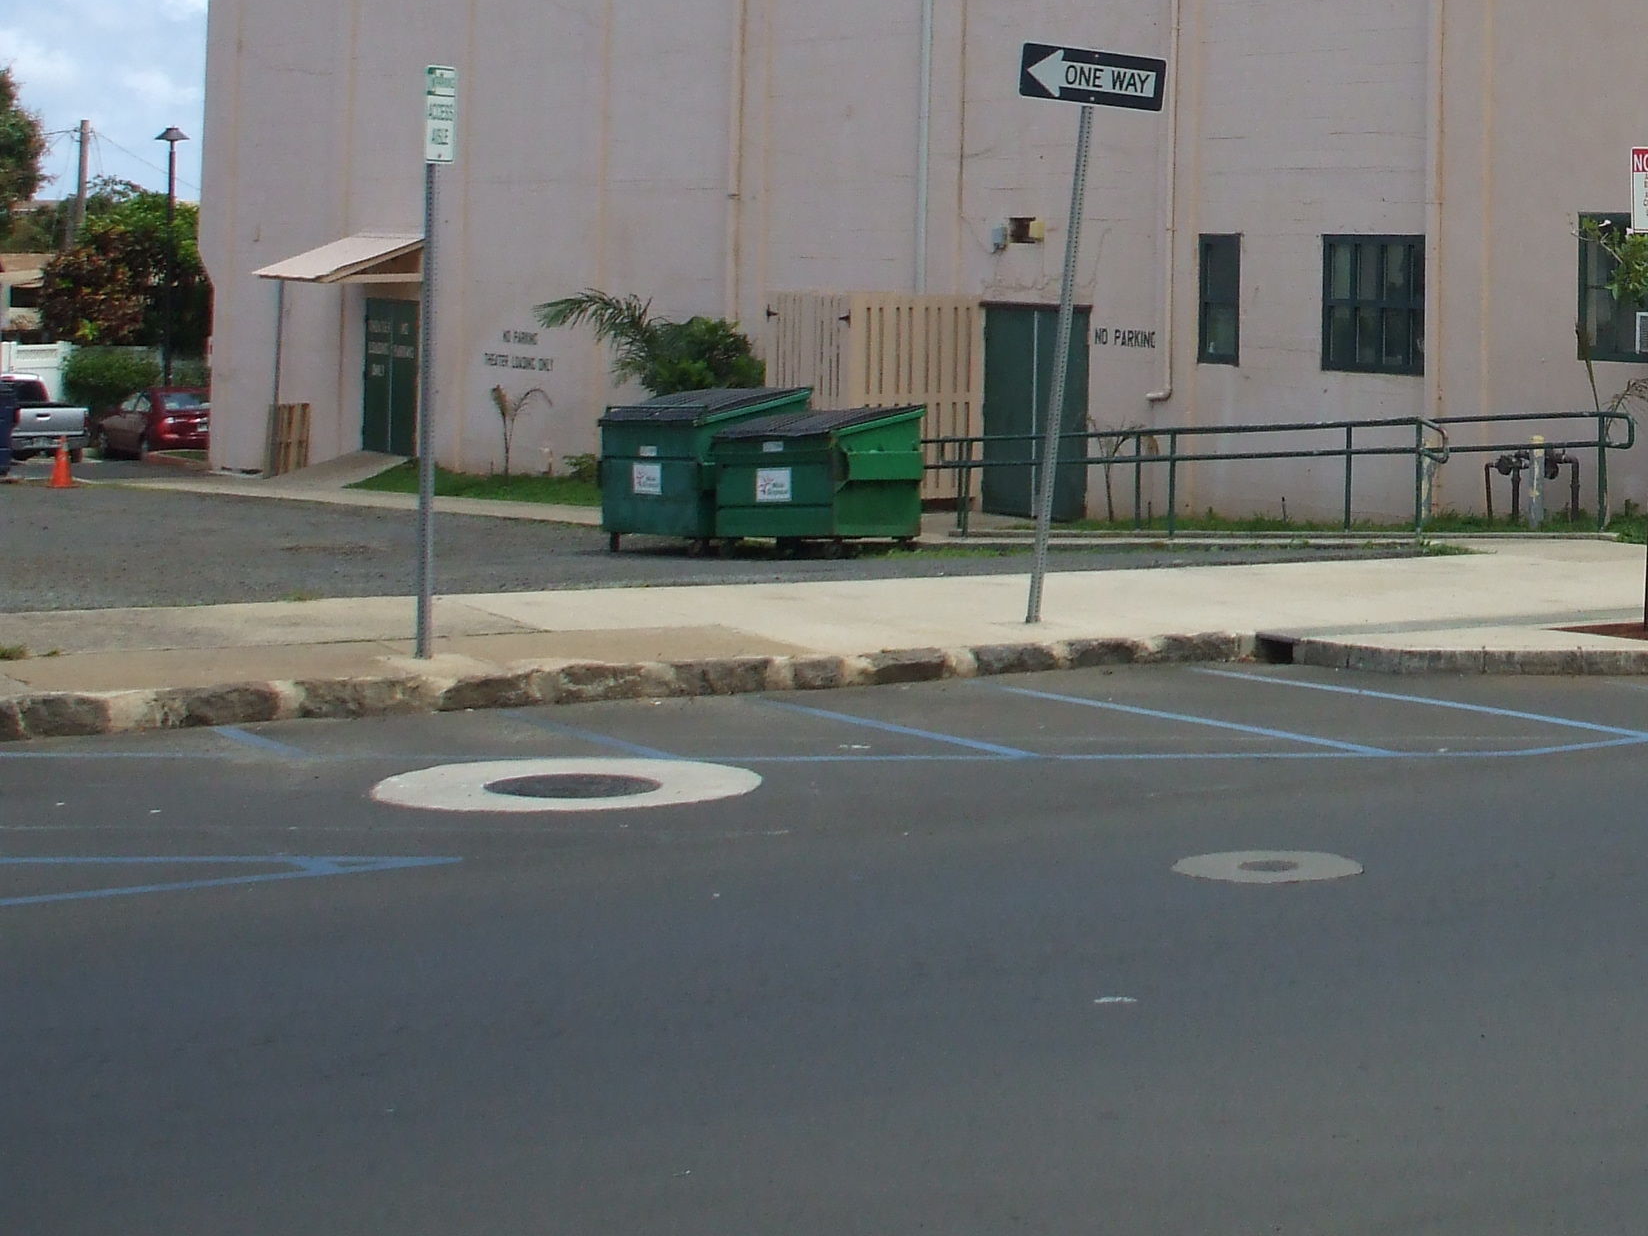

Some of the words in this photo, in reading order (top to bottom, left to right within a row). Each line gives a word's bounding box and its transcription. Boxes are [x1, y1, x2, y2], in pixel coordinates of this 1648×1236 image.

[1065, 65, 1104, 89] ONE
[1112, 70, 1150, 94] WAY
[502, 330, 511, 343] NO
[513, 330, 539, 346] PARKING
[1094, 328, 1108, 345] NO
[484, 352, 508, 367] THEATER
[511, 355, 536, 370] LOADING
[538, 358, 554, 372] ONLY
